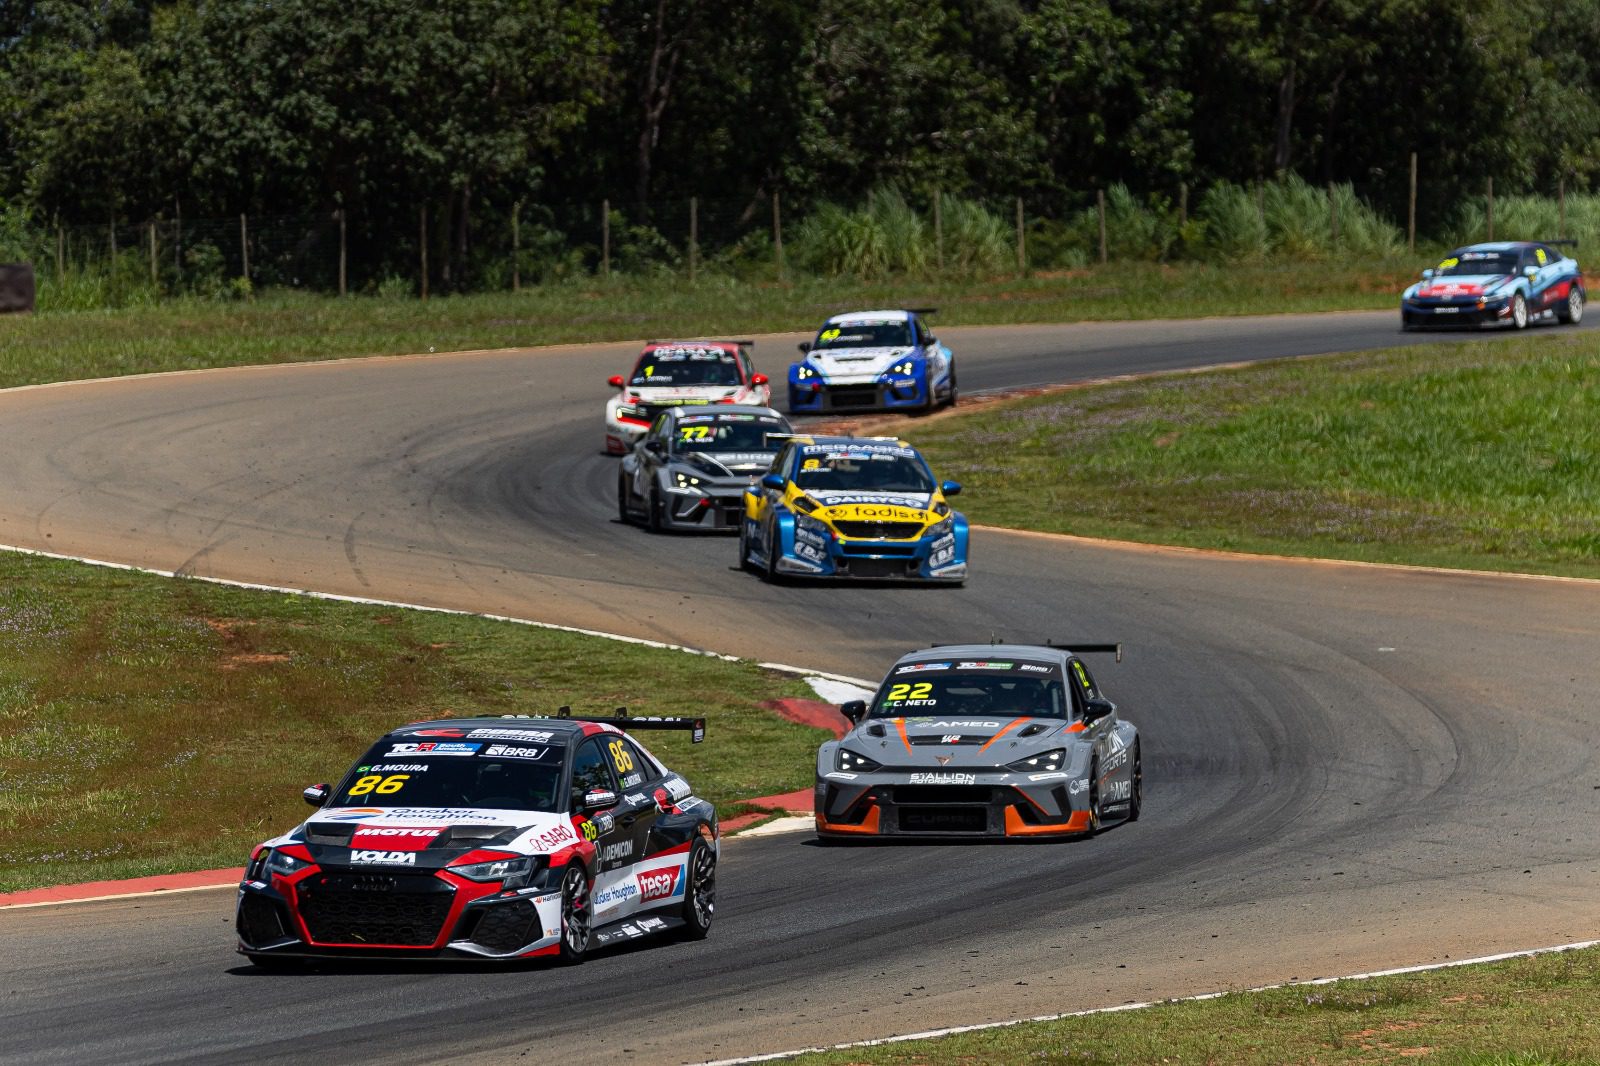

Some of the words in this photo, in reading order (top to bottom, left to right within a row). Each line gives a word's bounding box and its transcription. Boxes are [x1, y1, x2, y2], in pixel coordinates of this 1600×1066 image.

[681, 426, 709, 439] 77
[887, 682, 933, 700] 22
[392, 742, 438, 753] TCR
[502, 747, 539, 757] BRB
[608, 740, 634, 773] 86
[371, 764, 429, 773] G.MOURA
[910, 772, 976, 781] STALLION
[348, 775, 411, 796] 86
[355, 828, 441, 837] MOTUL
[581, 820, 597, 841] 86
[351, 850, 417, 863] VOLDA
[611, 882, 638, 901] Houghton
[640, 873, 672, 898] tesa
